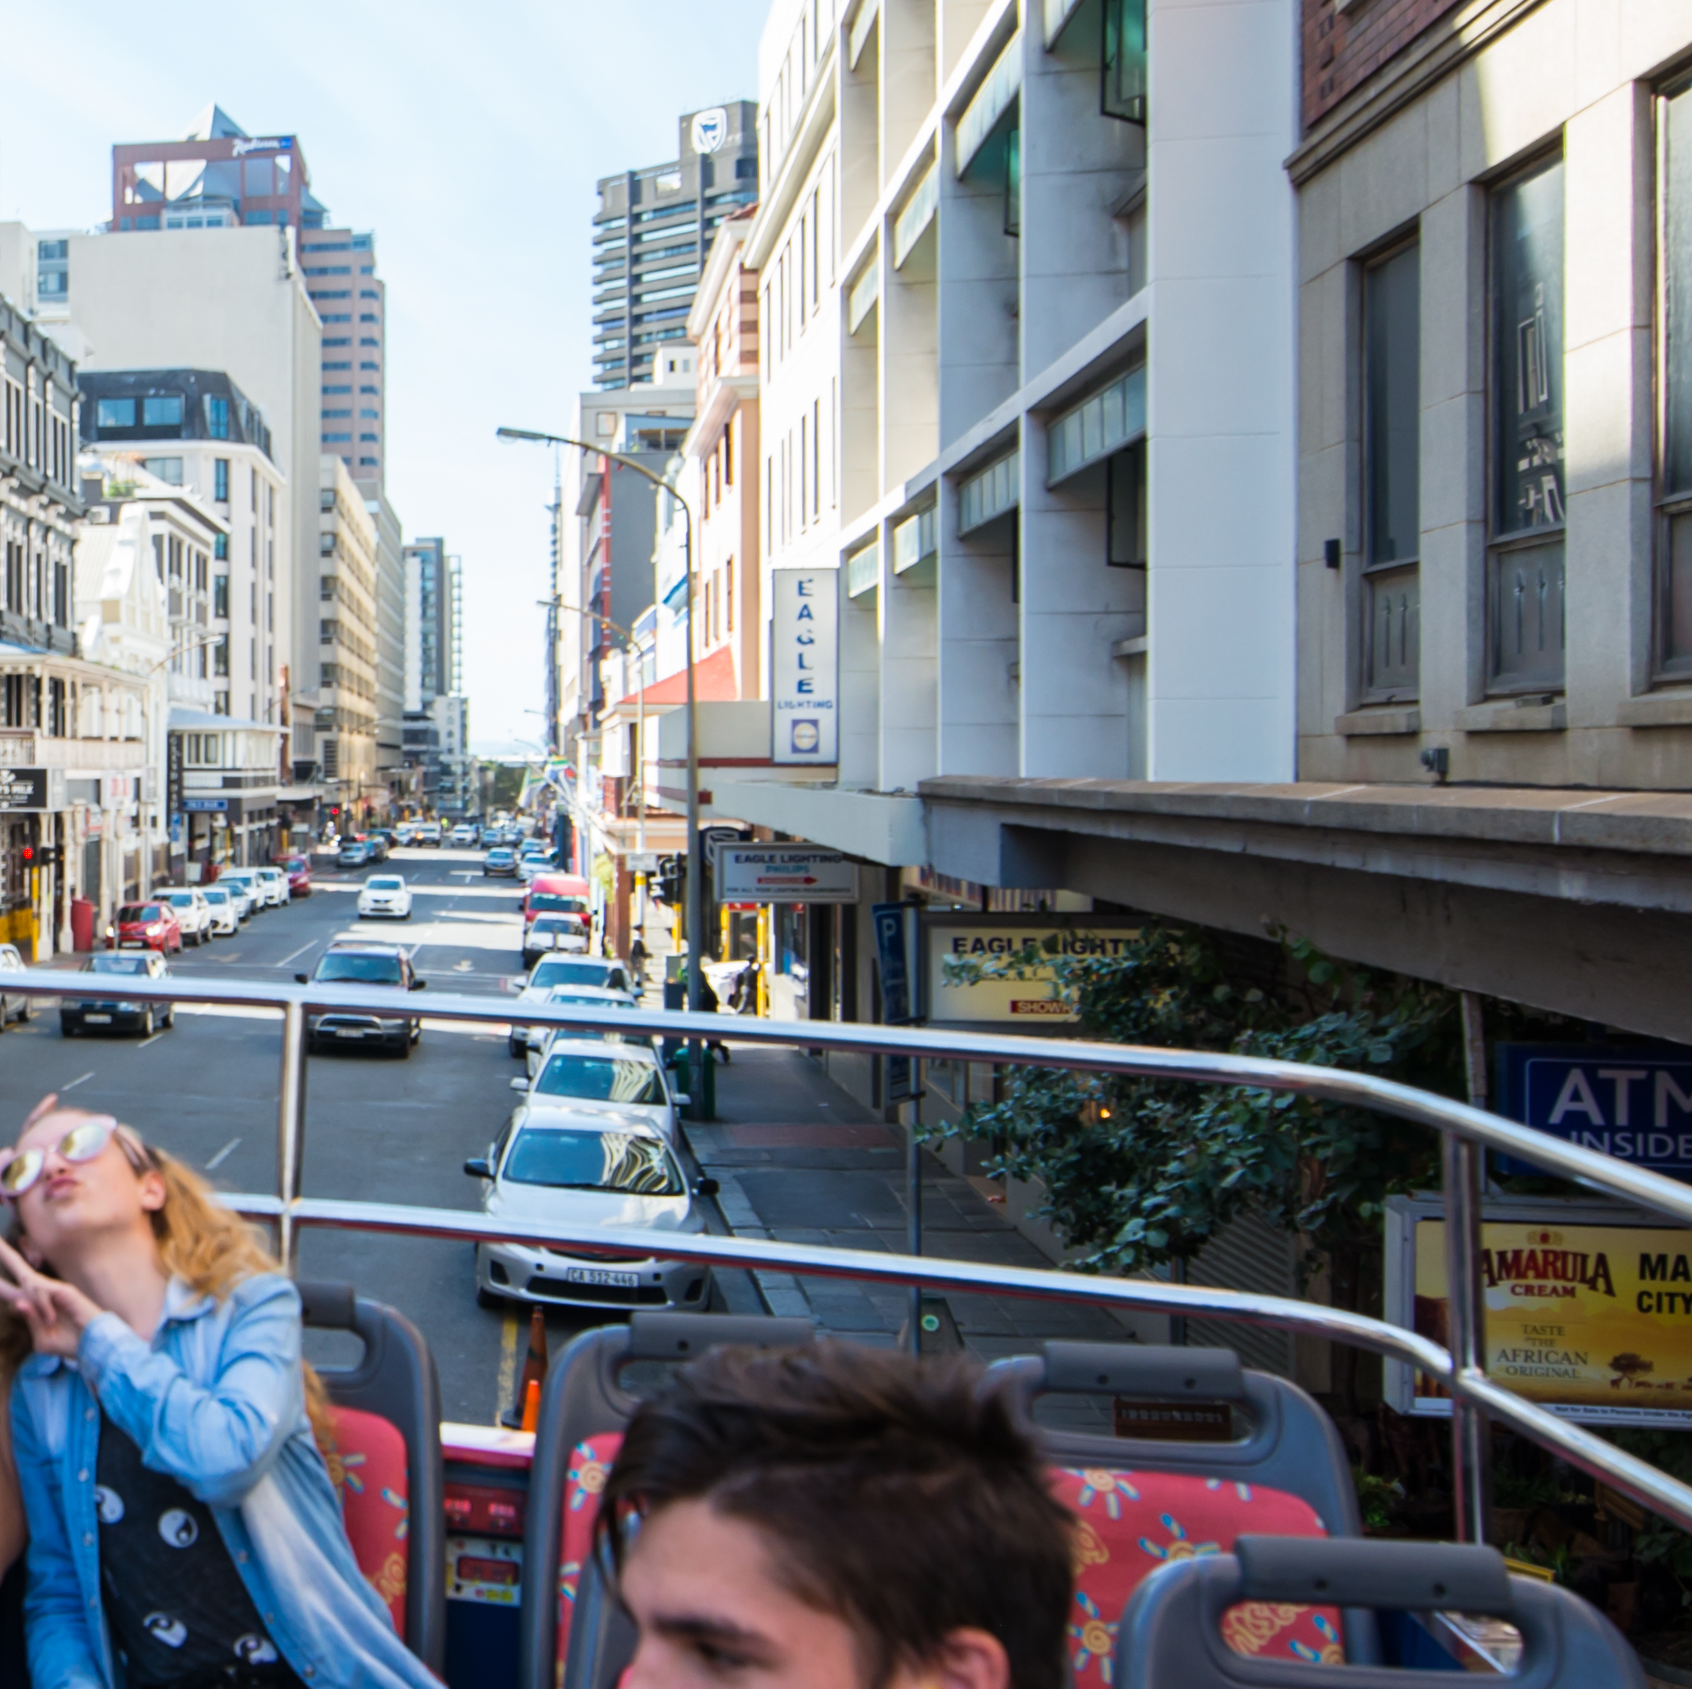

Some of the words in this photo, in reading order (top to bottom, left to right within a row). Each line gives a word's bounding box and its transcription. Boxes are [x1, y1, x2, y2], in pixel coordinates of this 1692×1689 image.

[796, 579, 815, 694] EAGLE
[777, 700, 834, 710] LIGHTING
[734, 853, 777, 864] EAGLE
[780, 853, 843, 864] LIGHTING
[1480, 1248, 1617, 1298] AMARULA
[1510, 1283, 1577, 1298] CREAM
[1521, 1324, 1565, 1337] TASTE
[1497, 1348, 1589, 1366] AFRICAN
[1505, 1365, 1581, 1379] ORIGINAL
